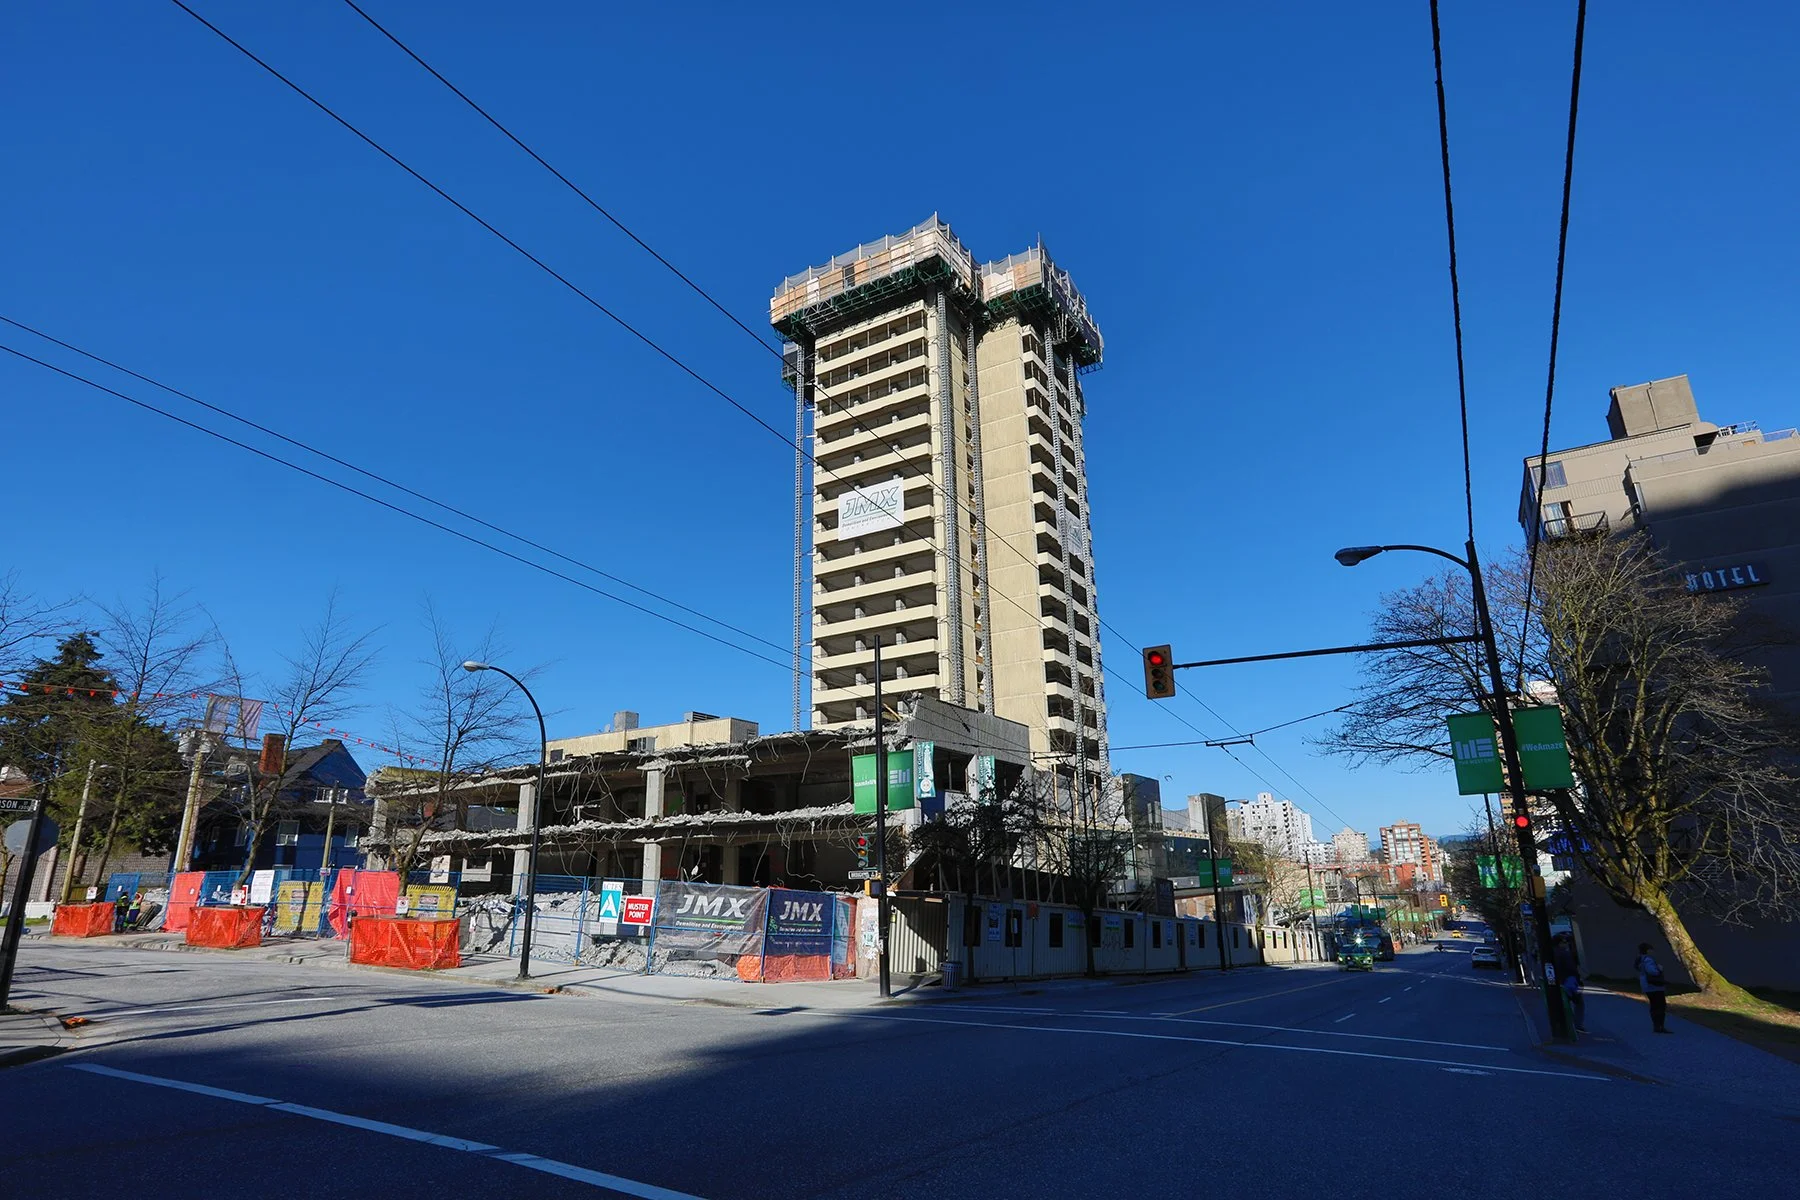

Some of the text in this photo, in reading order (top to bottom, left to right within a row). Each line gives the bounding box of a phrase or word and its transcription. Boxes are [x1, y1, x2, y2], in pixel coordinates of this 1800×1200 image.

[842, 486, 899, 519] JMX
[1686, 564, 1760, 592] HOTEL
[0, 800, 18, 809] SON
[627, 903, 649, 911] MUSTER
[628, 911, 645, 919] POINT
[676, 894, 749, 918] JMX
[779, 900, 823, 922] JMX
